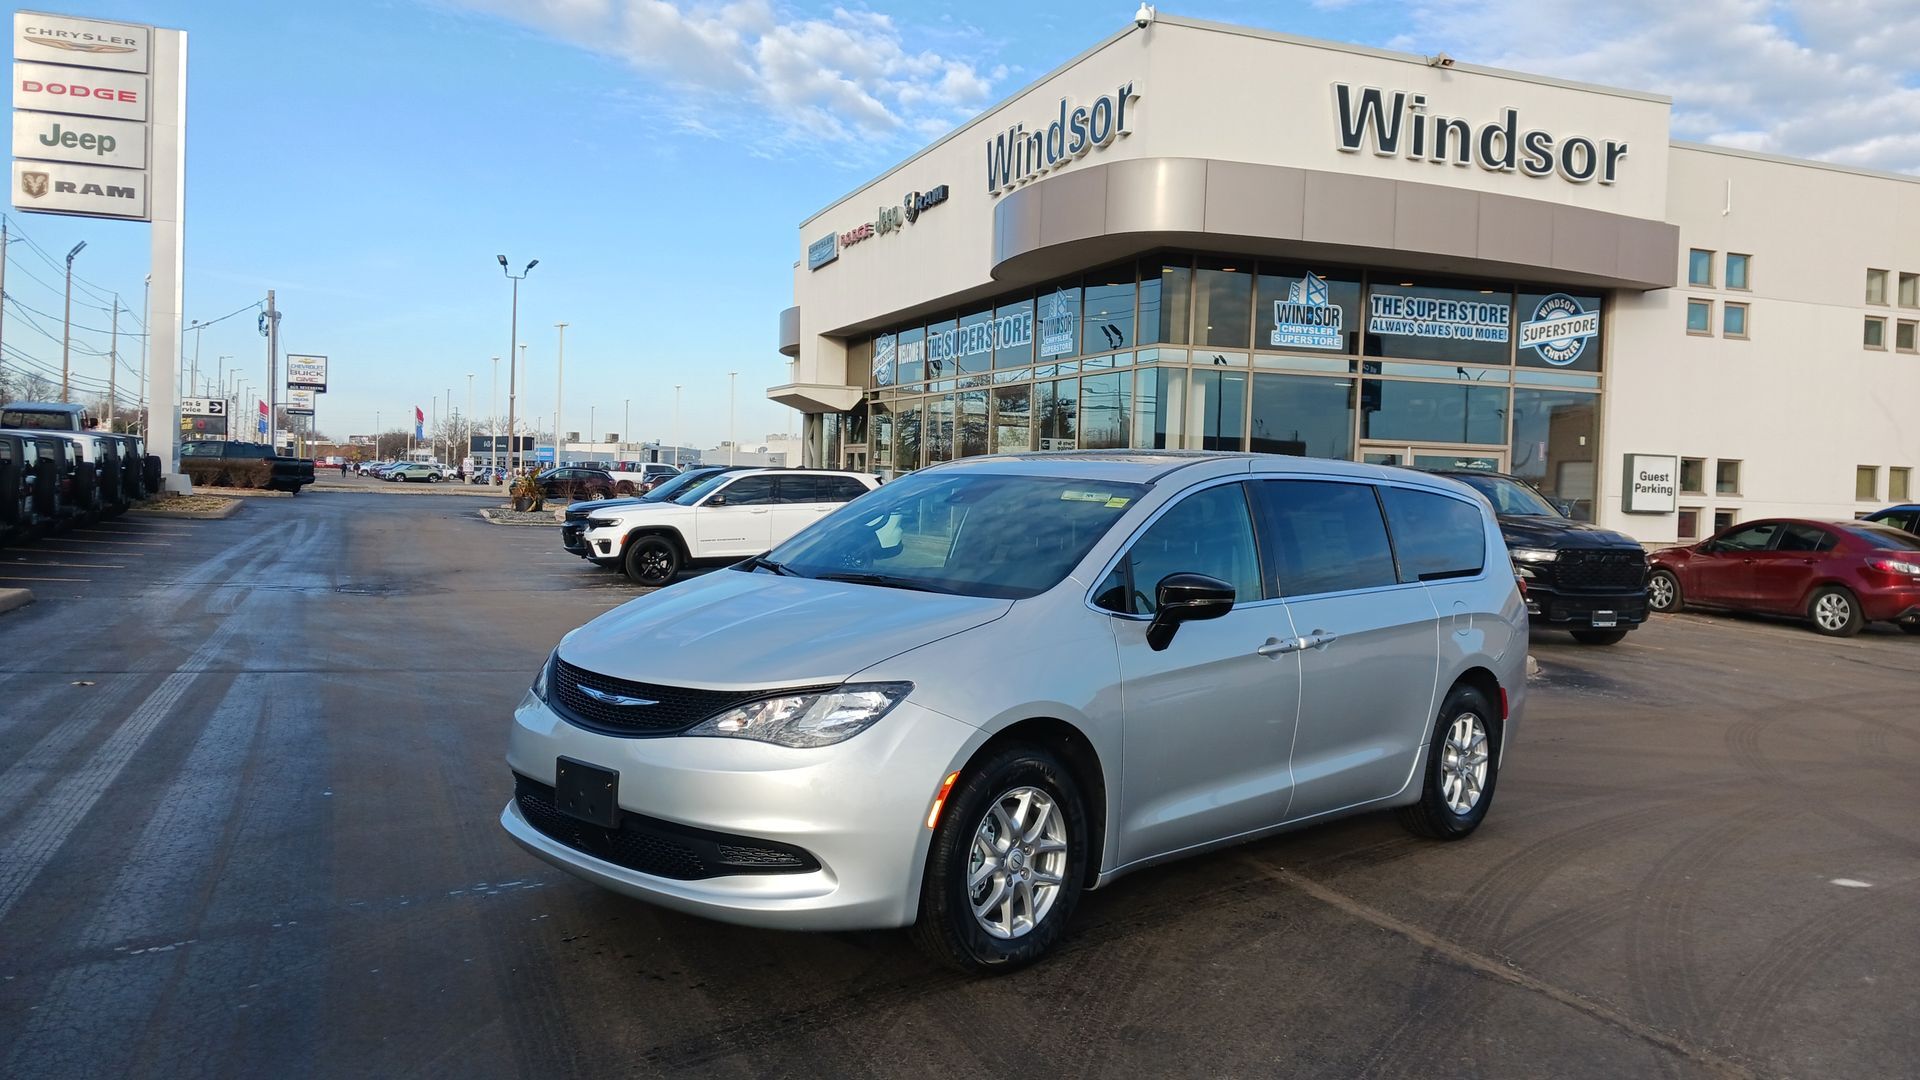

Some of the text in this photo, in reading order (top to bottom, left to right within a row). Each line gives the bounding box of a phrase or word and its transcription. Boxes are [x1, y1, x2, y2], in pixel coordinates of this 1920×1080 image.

[25, 26, 137, 46] CHRYSLER
[22, 80, 138, 104] DODGE
[39, 123, 117, 156] Jeep
[986, 80, 1138, 195] Windsor
[1331, 80, 1629, 185] Windsor
[54, 180, 136, 199] RAM
[914, 185, 949, 211] RAM
[875, 205, 904, 234] Jeep
[840, 222, 875, 247] DODGE
[1276, 303, 1340, 327] WINDSOR
[1373, 296, 1508, 324] THE SUPERSTORE
[1539, 299, 1576, 318] WINDSOR
[928, 334, 942, 360] THE
[944, 313, 1031, 358] SUPERSTORE
[1043, 314, 1072, 337] WINDSOR
[1281, 325, 1334, 336] CHRYSLER
[1372, 319, 1508, 340] ALWAYS SAVES YOU MORE!
[1523, 318, 1596, 342] SUPERSTORE
[1274, 334, 1341, 346] SUPERSTORE
[1544, 340, 1581, 360] CHRYSLER
[1639, 470, 1669, 482] Guest
[1635, 482, 1673, 496] Parking
